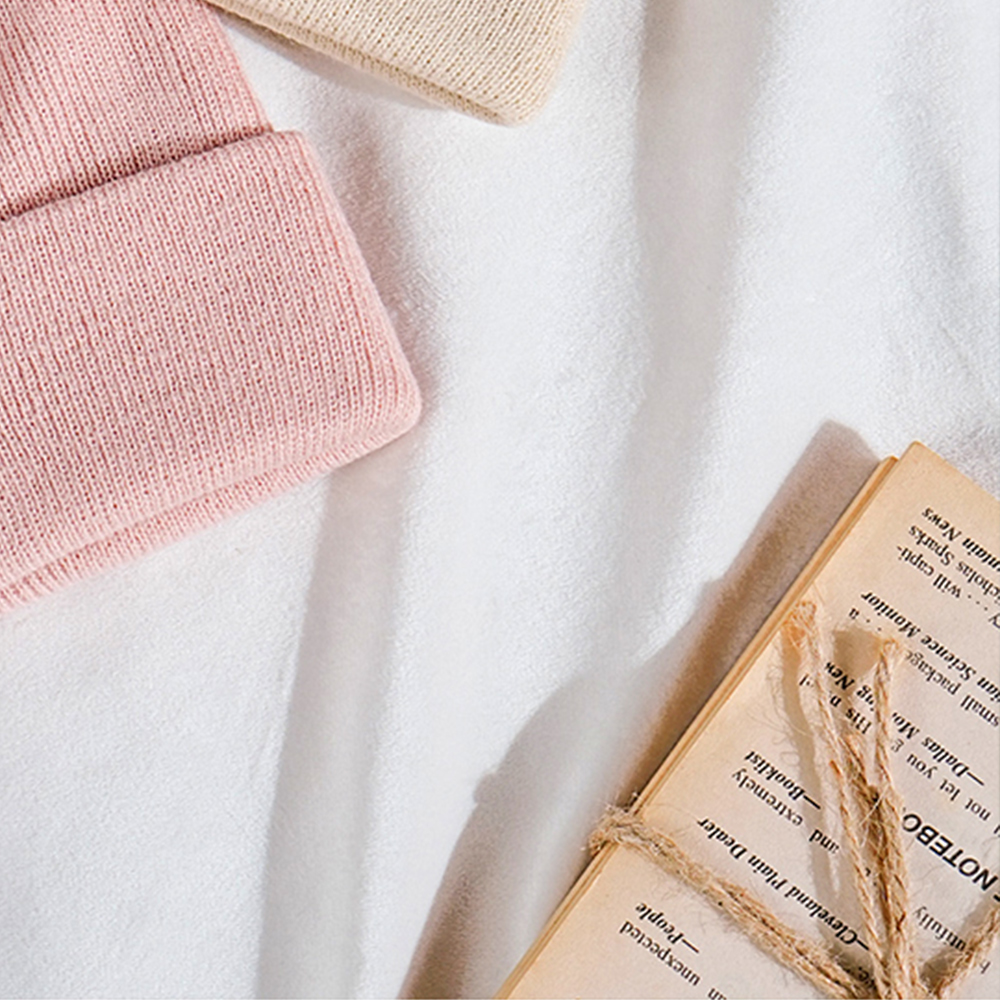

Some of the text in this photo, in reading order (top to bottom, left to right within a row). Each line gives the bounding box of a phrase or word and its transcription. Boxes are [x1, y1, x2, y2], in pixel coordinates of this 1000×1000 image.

[897, 545, 935, 577] capti-
[907, 525, 955, 568] Sparks
[921, 507, 1000, 575] ntain News
[932, 573, 962, 599] will
[849, 607, 860, 620] a
[860, 591, 921, 638] Monitor
[824, 661, 855, 691] New
[921, 634, 977, 682] Science
[960, 693, 1000, 728] small
[744, 750, 821, 810] —Booklist
[906, 753, 938, 780] you
[921, 736, 985, 786] —Dallas
[731, 767, 804, 826] extremely
[939, 779, 961, 802] let
[964, 798, 991, 822] not
[809, 829, 840, 855] and
[902, 811, 999, 891] NOTEBO
[697, 816, 869, 951] —Cleveland Plain Dealer
[635, 902, 700, 954] —People
[619, 920, 701, 987] unexpected
